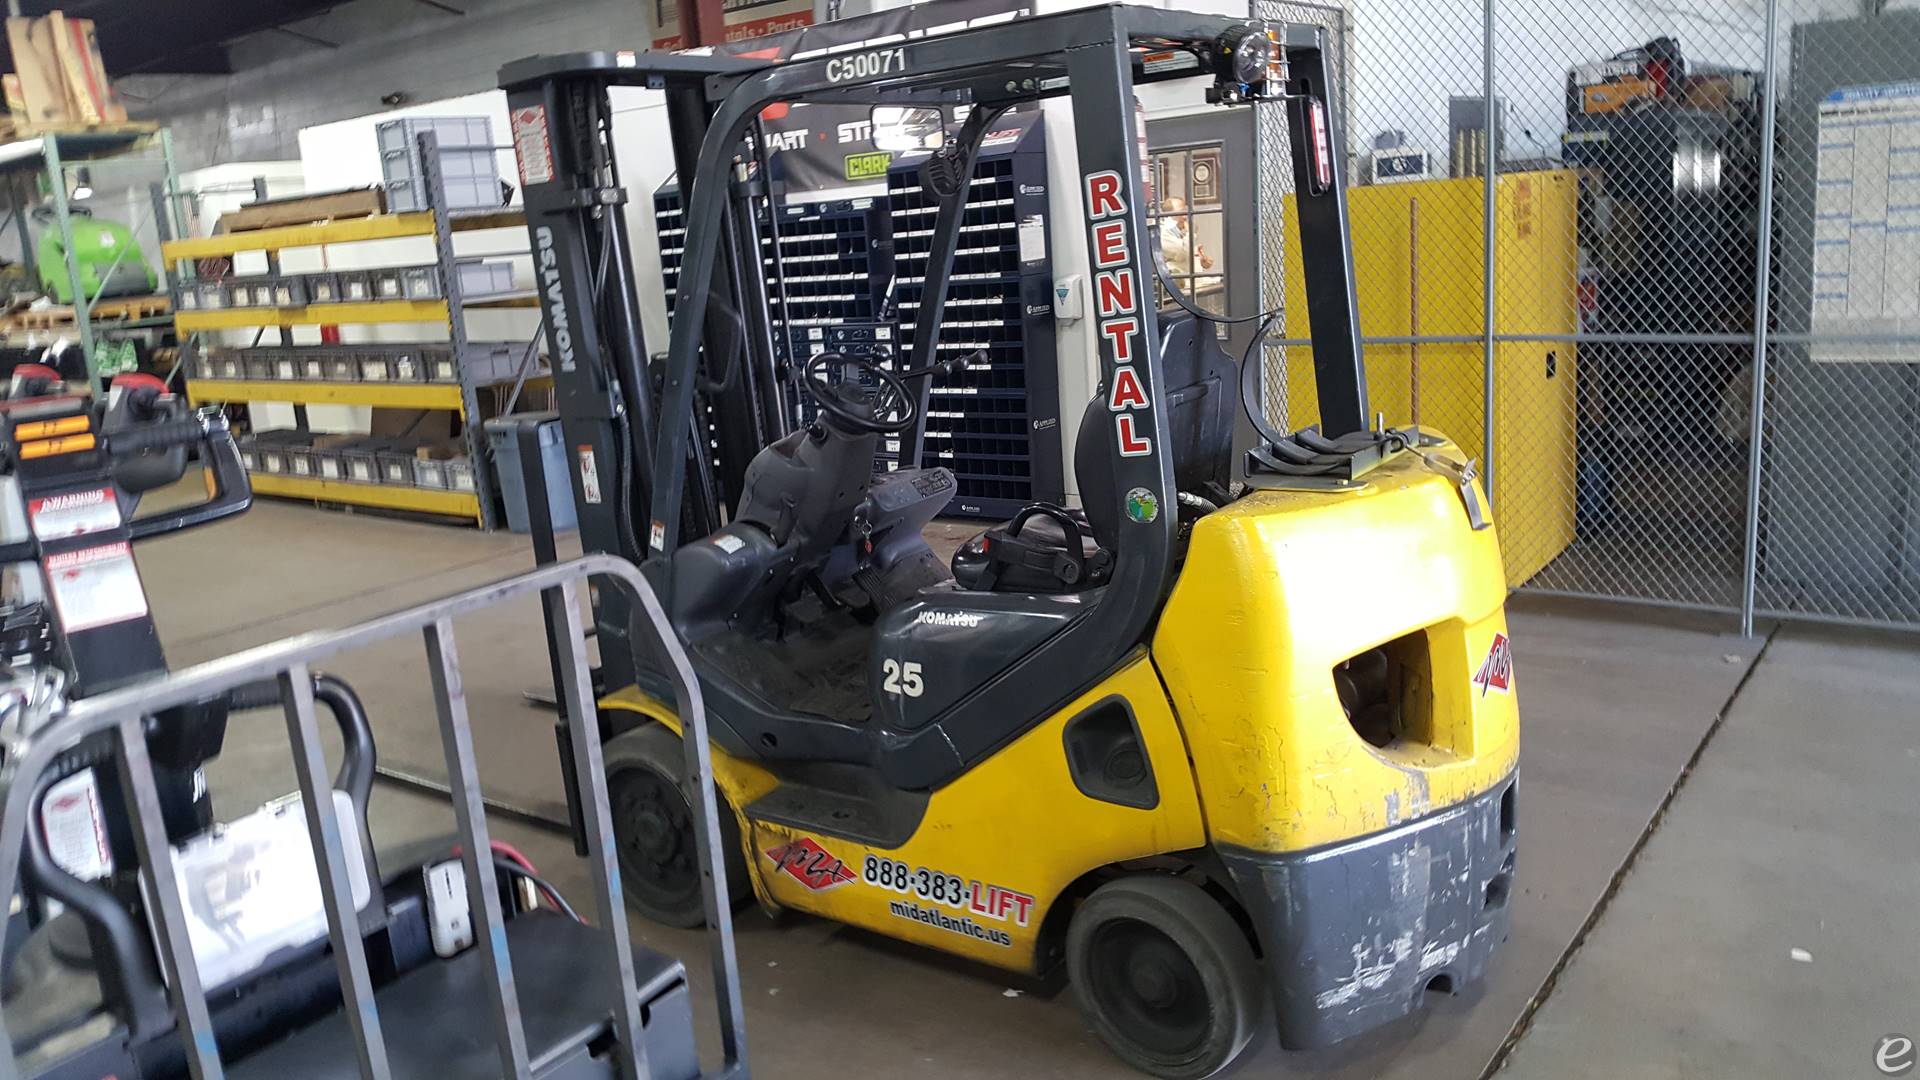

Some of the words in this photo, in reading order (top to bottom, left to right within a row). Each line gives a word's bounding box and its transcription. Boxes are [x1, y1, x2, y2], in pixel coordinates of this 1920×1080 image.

[768, 18, 804, 35] Parts
[826, 48, 906, 83] C50071
[850, 155, 892, 177] CLARK
[536, 226, 576, 372] KOMATSU
[1087, 172, 1151, 455] RENTAL
[918, 611, 978, 627] KOMATSU
[883, 658, 924, 697] 25
[890, 900, 1011, 946] midatlantic.us
